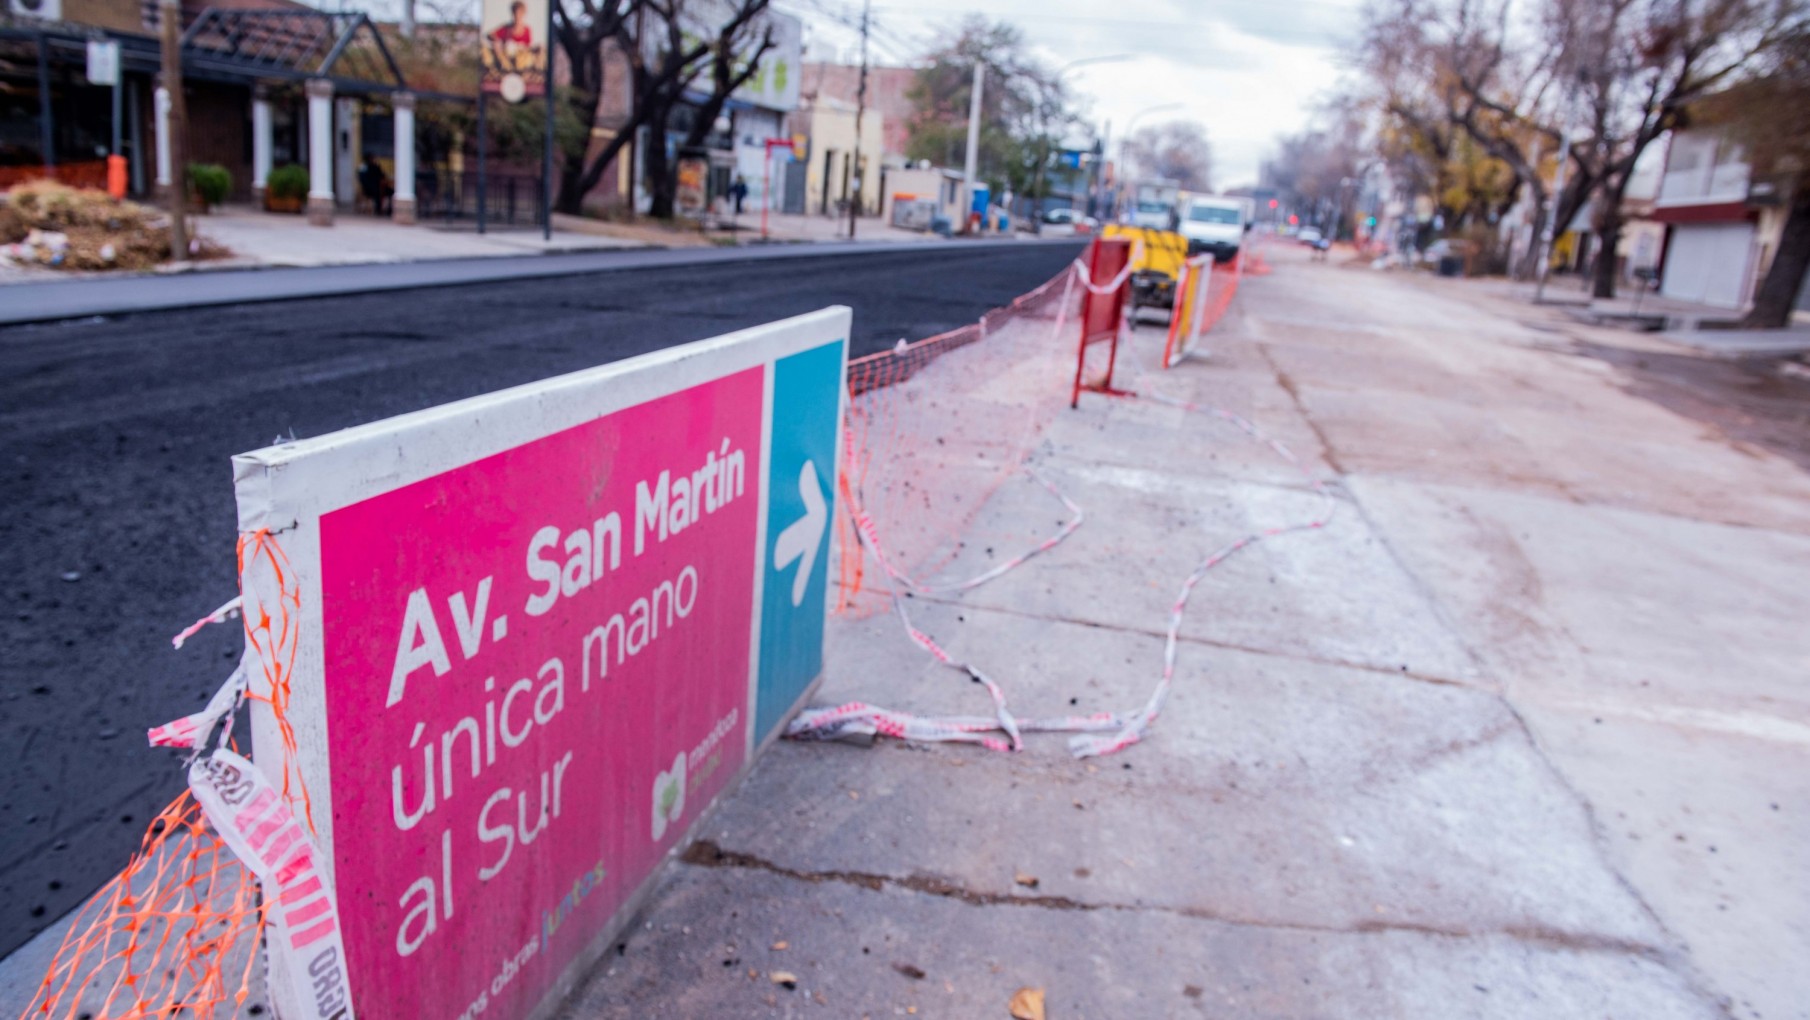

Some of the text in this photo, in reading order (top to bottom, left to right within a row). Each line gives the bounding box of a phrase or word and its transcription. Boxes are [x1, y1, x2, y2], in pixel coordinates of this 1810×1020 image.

[386, 437, 745, 707] Av. San Martín
[391, 565, 698, 831] única mano
[396, 829, 454, 957] al
[477, 751, 573, 882] Sur
[491, 934, 539, 996] obras
